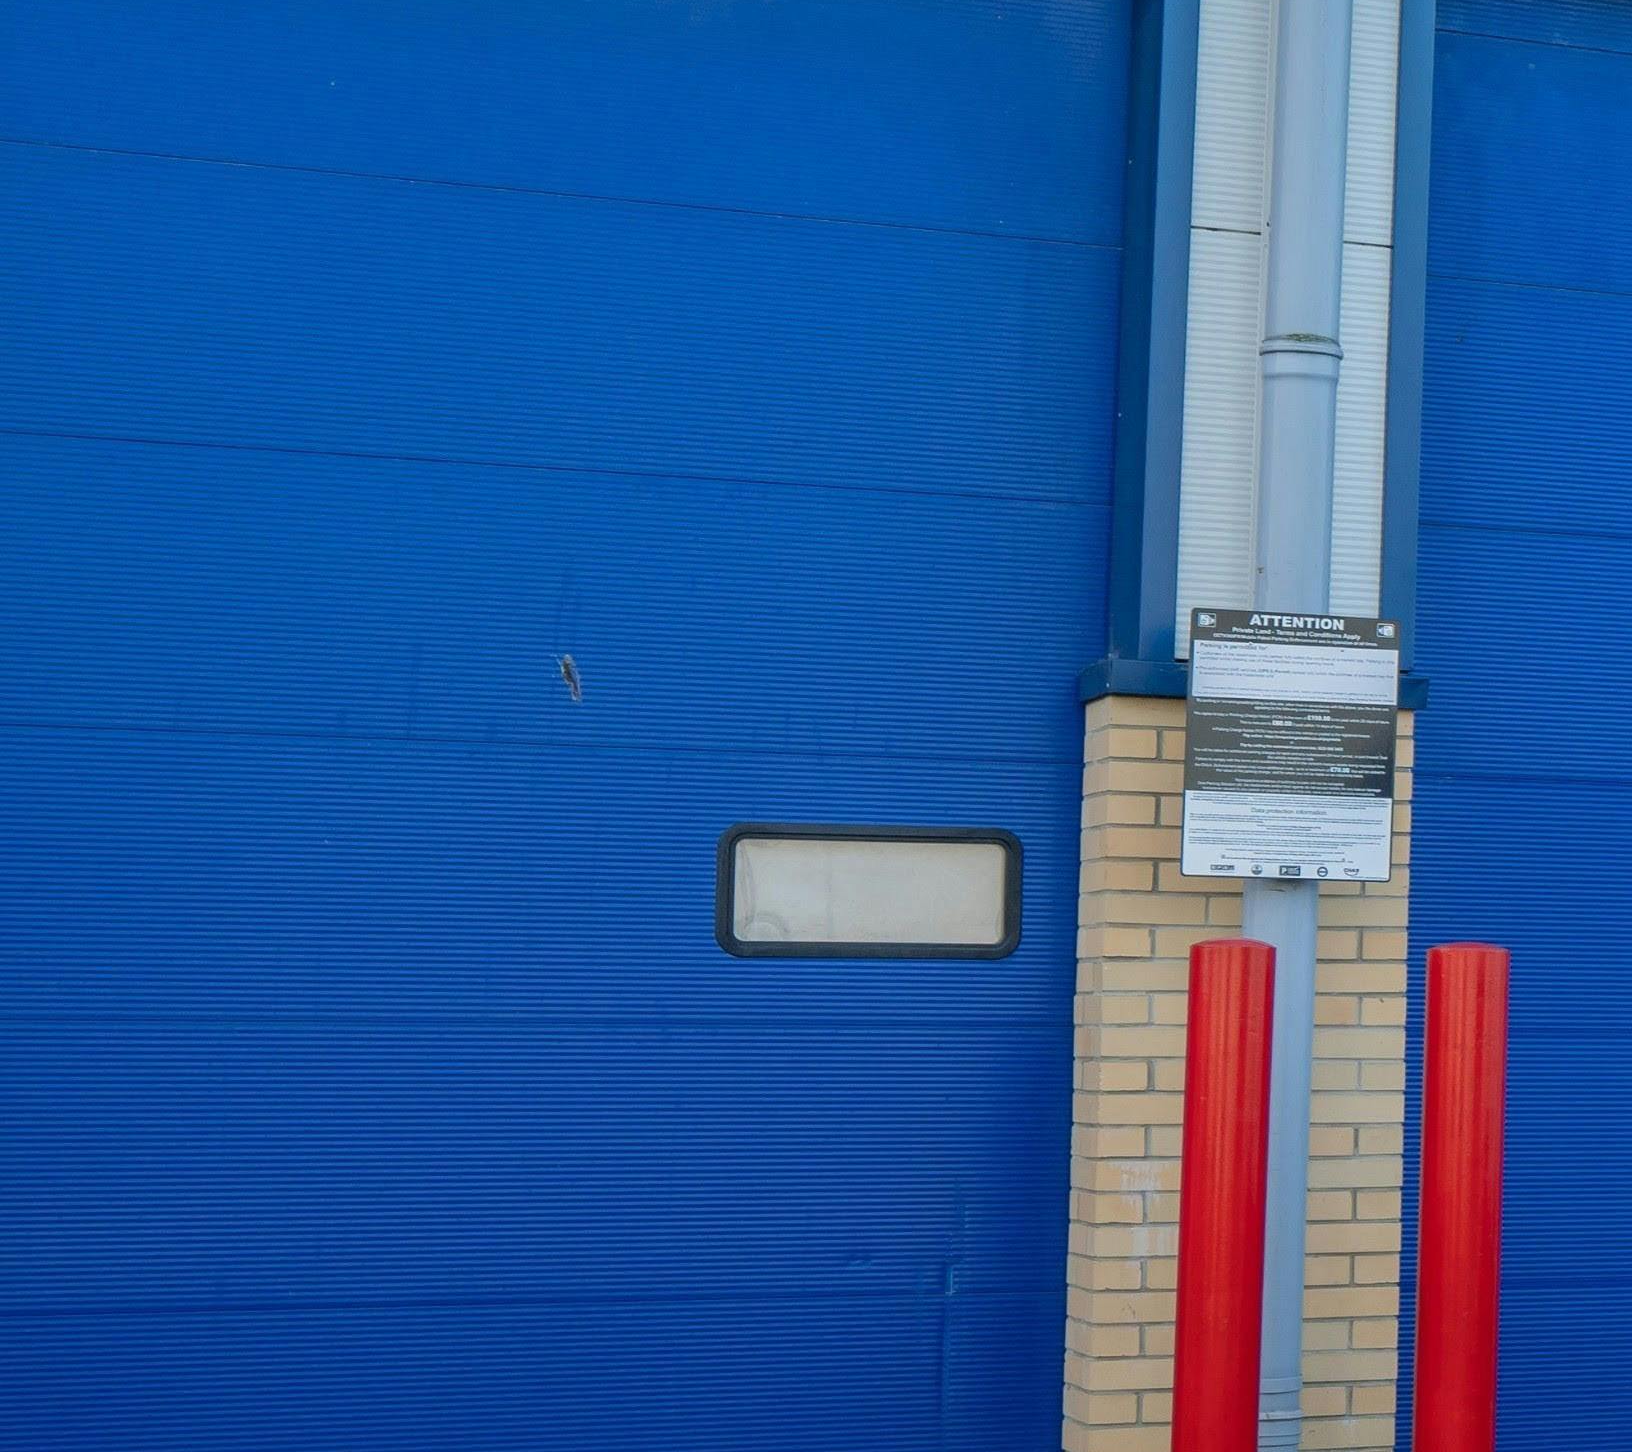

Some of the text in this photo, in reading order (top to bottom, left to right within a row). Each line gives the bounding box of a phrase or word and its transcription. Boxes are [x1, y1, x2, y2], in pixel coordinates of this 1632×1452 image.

[1249, 614, 1345, 631] ATTENTION
[1231, 627, 1254, 635] Private
[1309, 631, 1342, 639] Conditions
[1343, 633, 1361, 641] Apply
